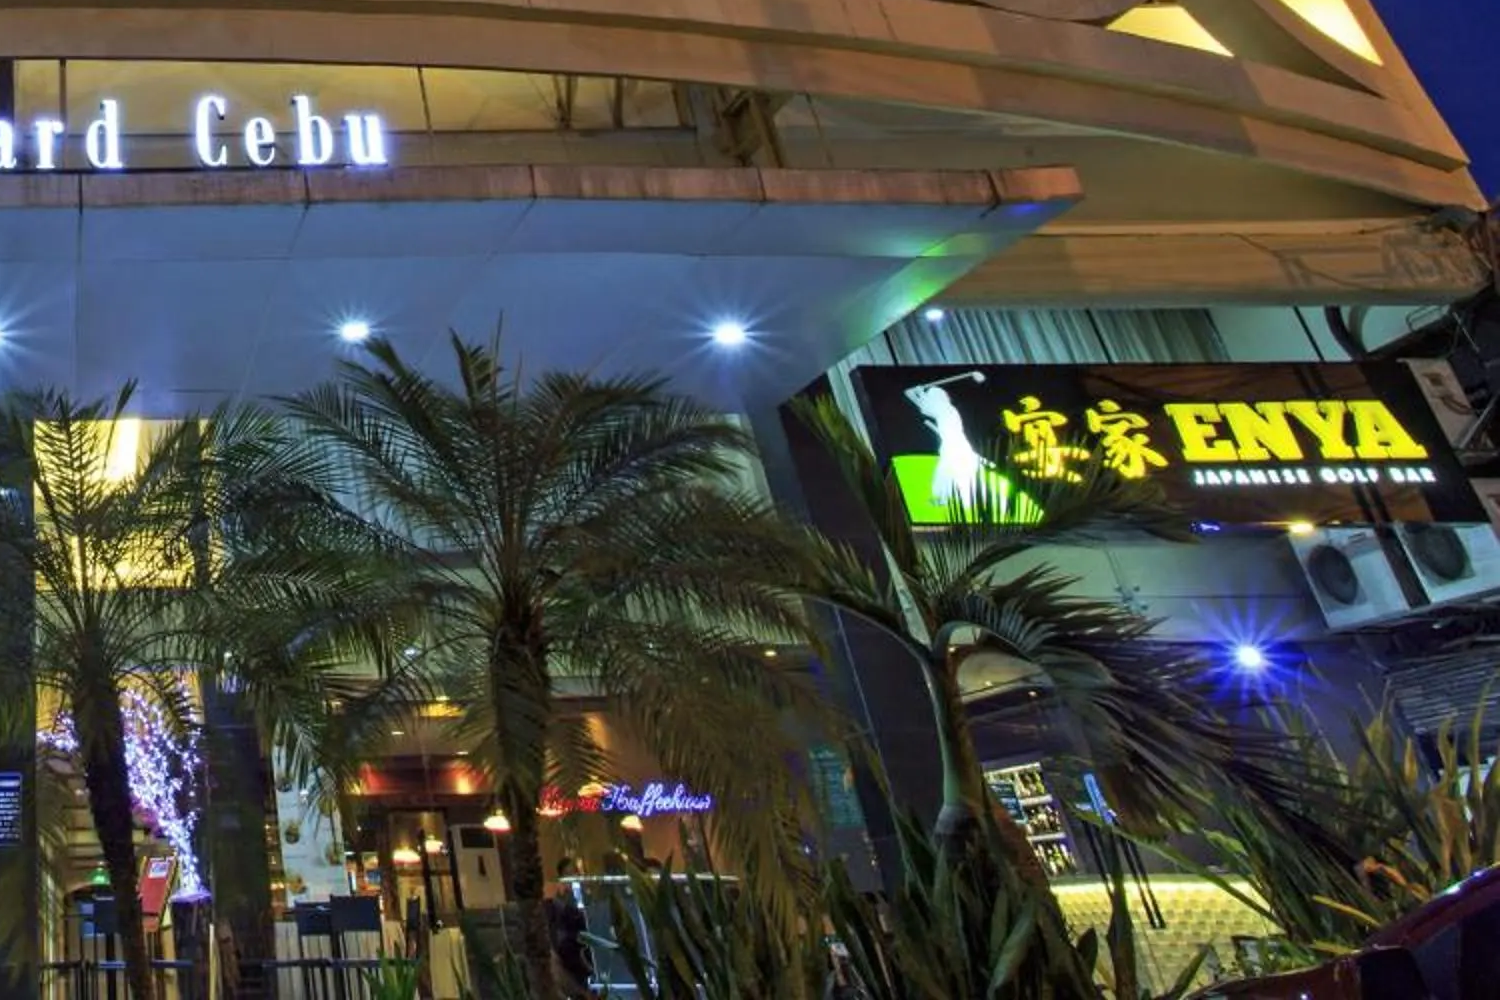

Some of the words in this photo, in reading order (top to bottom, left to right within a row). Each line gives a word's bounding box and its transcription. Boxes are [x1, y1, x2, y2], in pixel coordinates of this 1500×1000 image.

[194, 95, 389, 168] Cebu
[1163, 400, 1429, 463] ENYA
[1194, 468, 1312, 486] JAPANESE
[1319, 467, 1380, 485] GOLF
[1389, 467, 1437, 484] BAR
